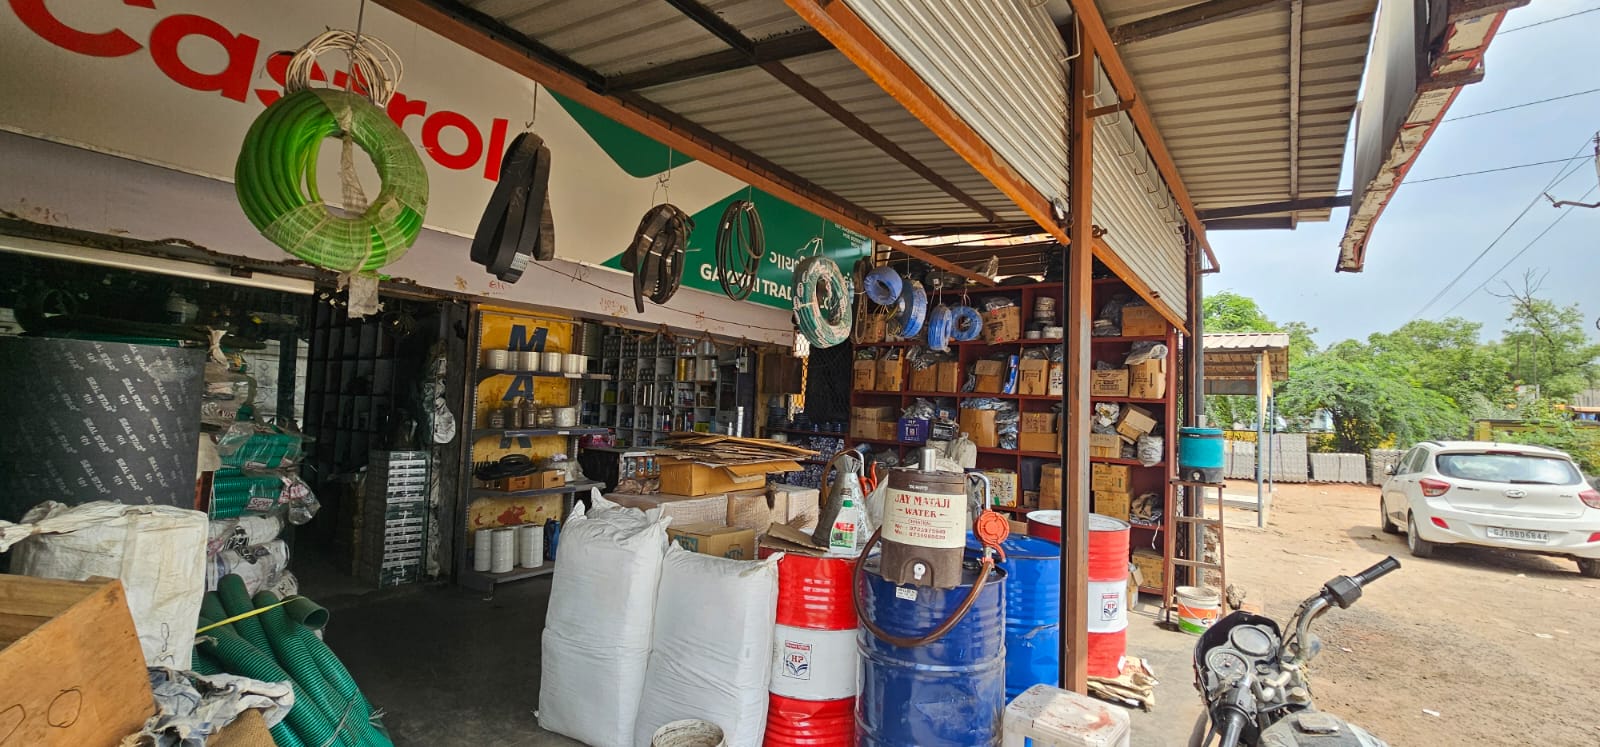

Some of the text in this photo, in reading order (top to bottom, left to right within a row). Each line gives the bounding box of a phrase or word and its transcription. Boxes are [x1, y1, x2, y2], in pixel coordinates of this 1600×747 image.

[895, 494, 950, 508] JAY MATAJI
[905, 507, 937, 518] WATER
[791, 655, 803, 663] HP
